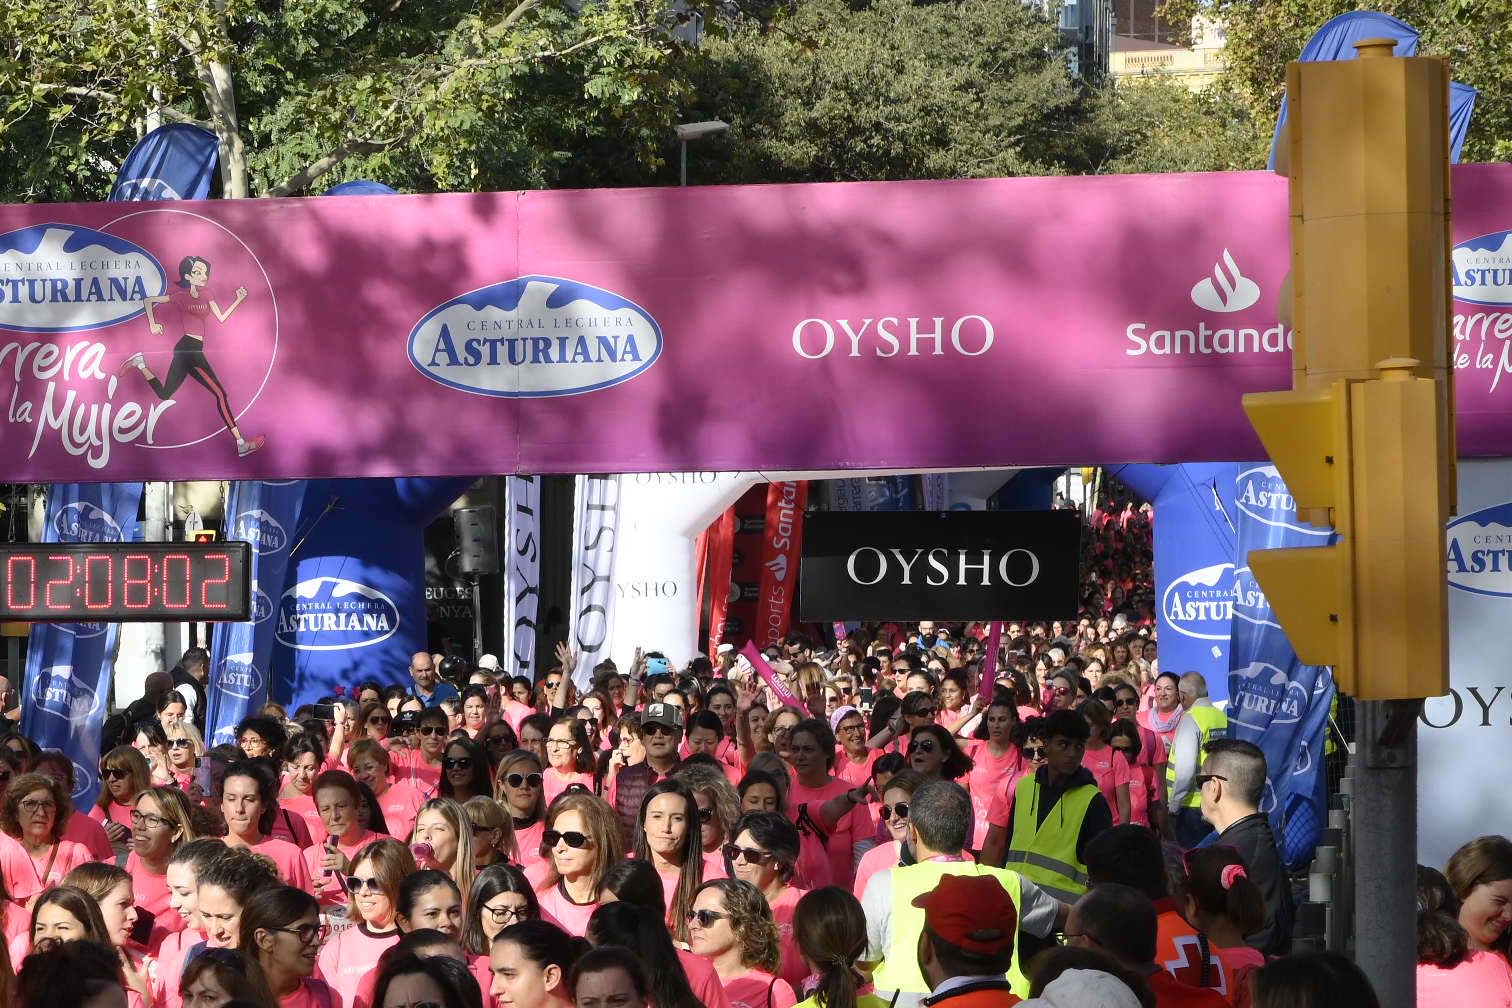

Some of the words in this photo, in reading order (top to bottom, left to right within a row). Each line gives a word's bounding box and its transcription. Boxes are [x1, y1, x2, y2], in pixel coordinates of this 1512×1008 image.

[71, 259, 142, 271] LECHERA
[467, 318, 545, 331] CENTRAL
[553, 315, 634, 329] LECHERA
[792, 315, 995, 359] OYSHO
[428, 322, 643, 368] ASTURIANA
[1476, 342, 1494, 369] la
[10, 385, 33, 424] la
[28, 375, 176, 469] Mujer
[6, 554, 231, 609] 02:08:02
[515, 473, 538, 668] OYSH
[577, 474, 616, 652] OYSH
[847, 546, 1040, 587] OYSHO
[617, 581, 677, 598] YSHO
[278, 607, 390, 633] ASTURIANA
